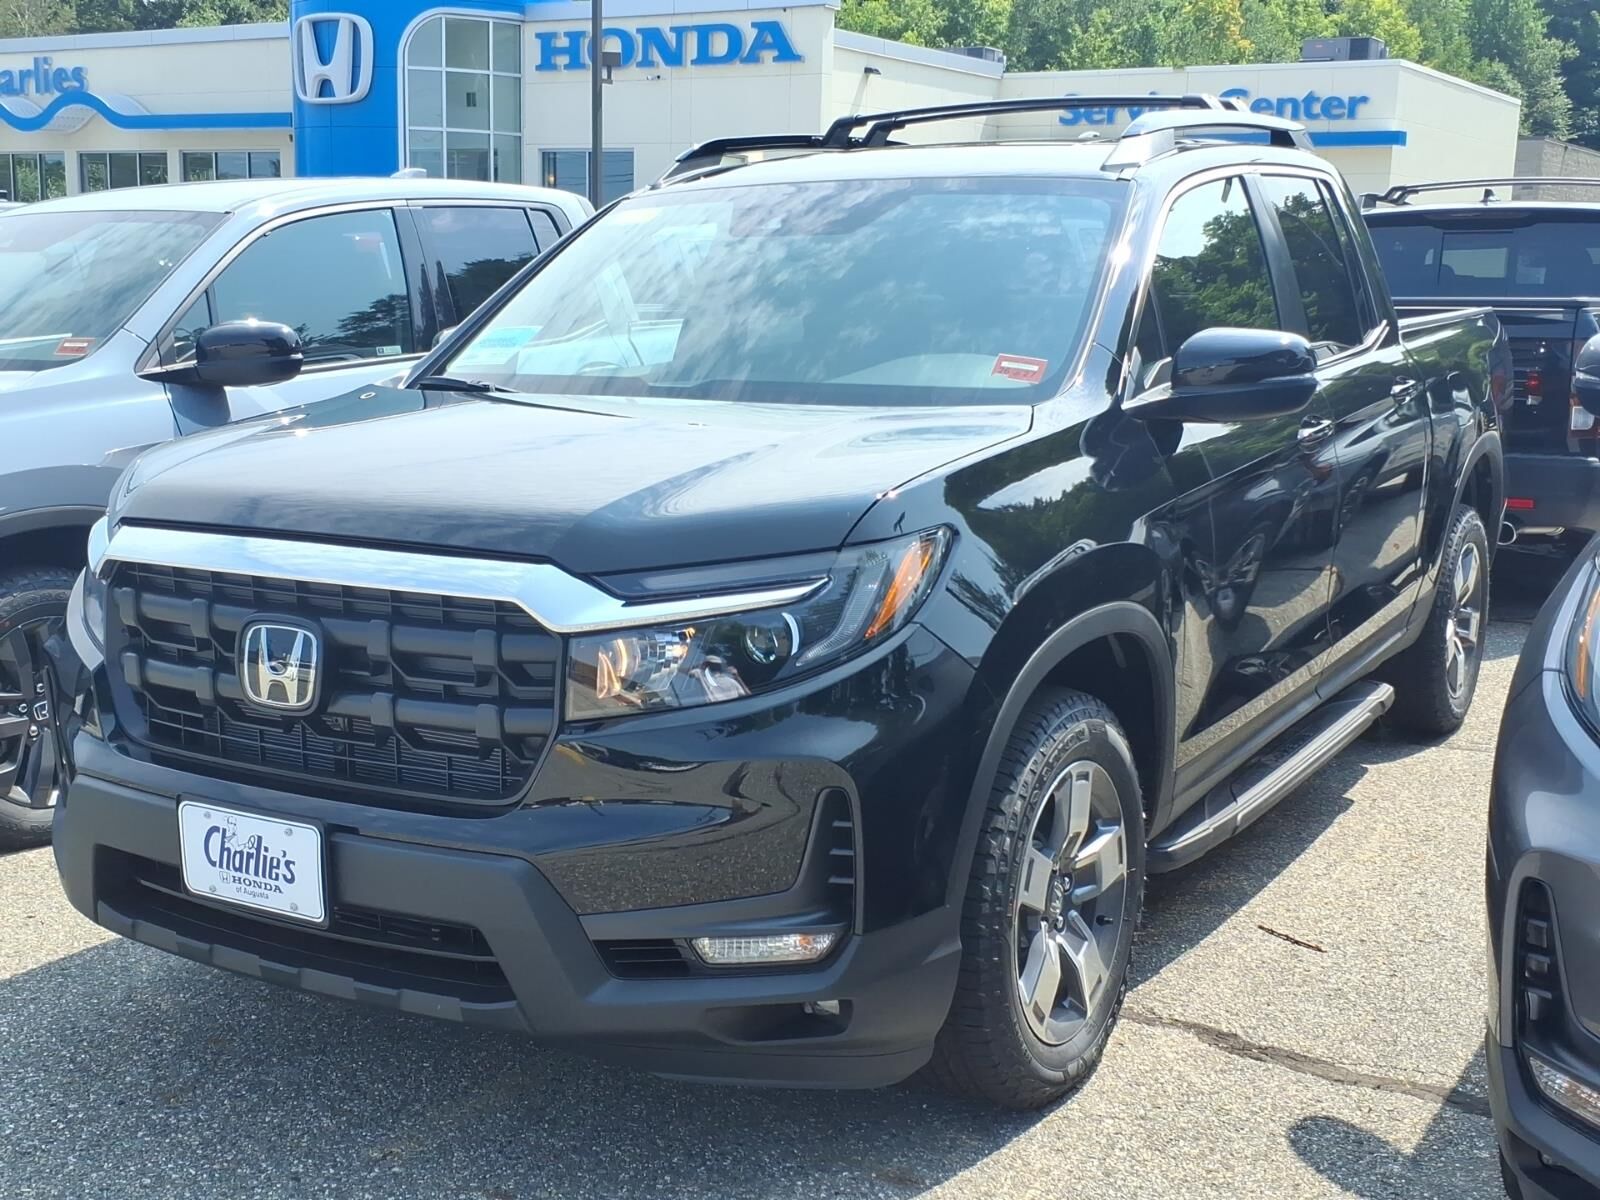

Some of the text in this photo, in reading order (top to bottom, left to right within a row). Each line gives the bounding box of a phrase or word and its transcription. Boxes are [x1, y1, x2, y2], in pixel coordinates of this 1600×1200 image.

[534, 20, 805, 72] HONDA
[203, 825, 296, 885] Charlie's
[231, 875, 284, 894] HONDA
[243, 887, 269, 900] Augusta
